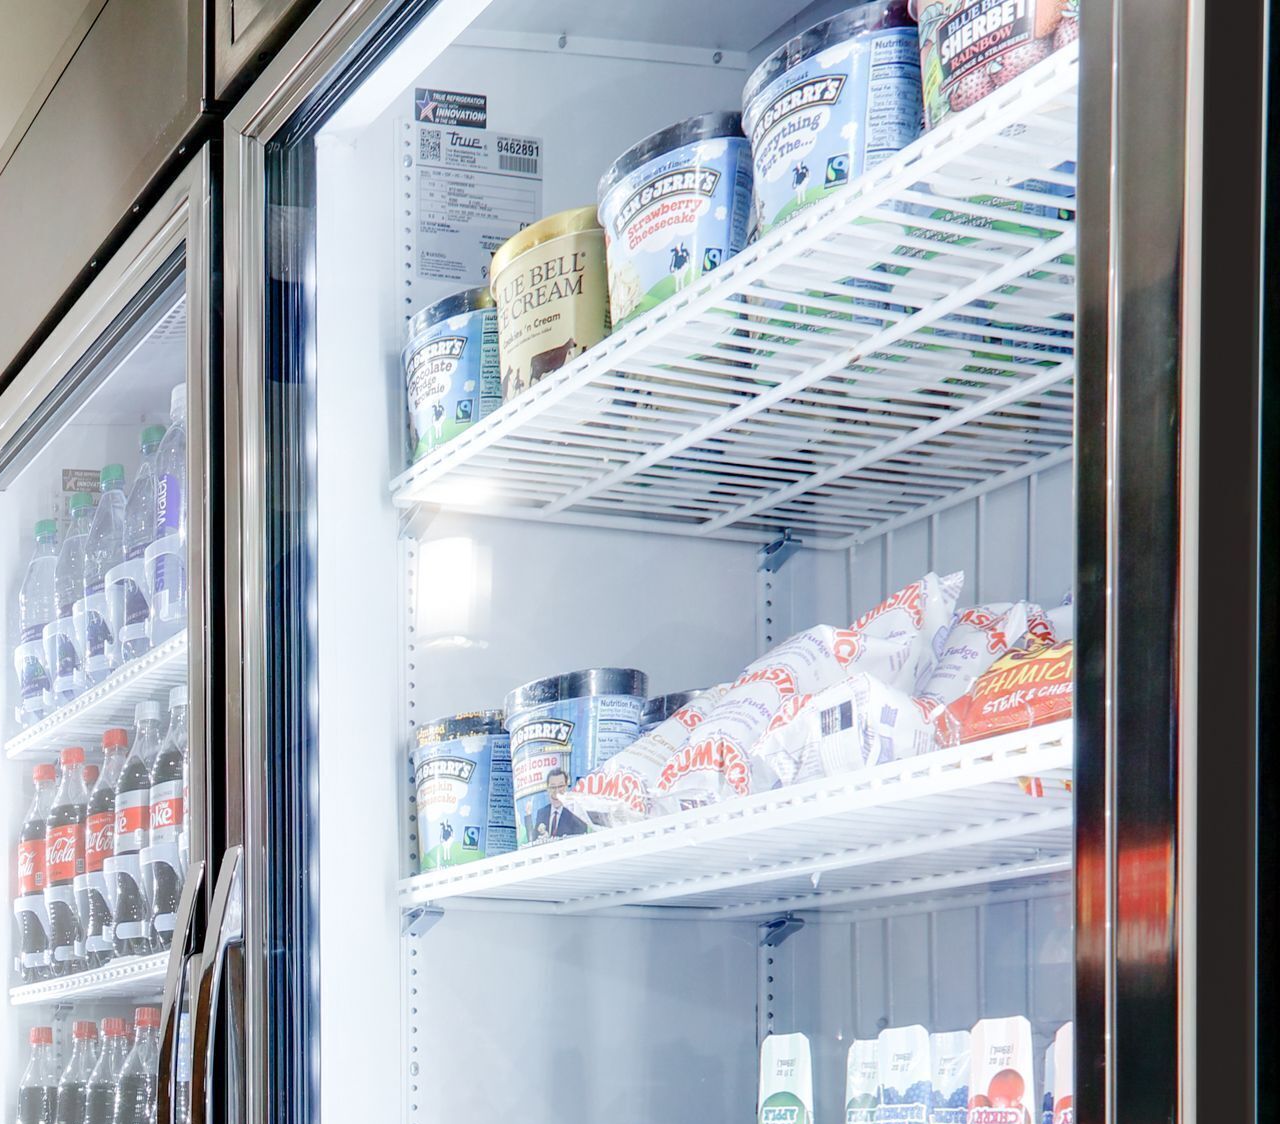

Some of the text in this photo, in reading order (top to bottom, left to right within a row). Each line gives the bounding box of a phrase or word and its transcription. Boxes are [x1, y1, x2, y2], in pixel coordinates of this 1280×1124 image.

[941, 0, 1026, 65] SHERBET
[947, 7, 982, 36] BLUE
[949, 23, 1015, 71] RAINBOW
[433, 93, 486, 105] TRUE REFRIGERATION
[773, 78, 841, 120] JERRY'S
[436, 107, 483, 121] INNOVATION
[446, 131, 483, 149] true
[497, 141, 539, 158] 9462891
[755, 112, 824, 170] Everything
[652, 172, 716, 198] JERRY'S
[628, 199, 704, 239] Strawberry
[629, 211, 696, 251] Cheesecake
[530, 251, 586, 288] BELL
[512, 275, 585, 323] CREAM
[533, 312, 561, 329] Cream
[802, 633, 832, 659] Fudge
[947, 644, 981, 660] Fudge
[975, 661, 1073, 701] CHIMIC
[742, 697, 774, 720] Fudge
[982, 692, 1022, 715] STEAK
[524, 721, 569, 743] JERRY'S
[430, 759, 471, 780] JERRY'S
[762, 1106, 798, 1122] APPLE
